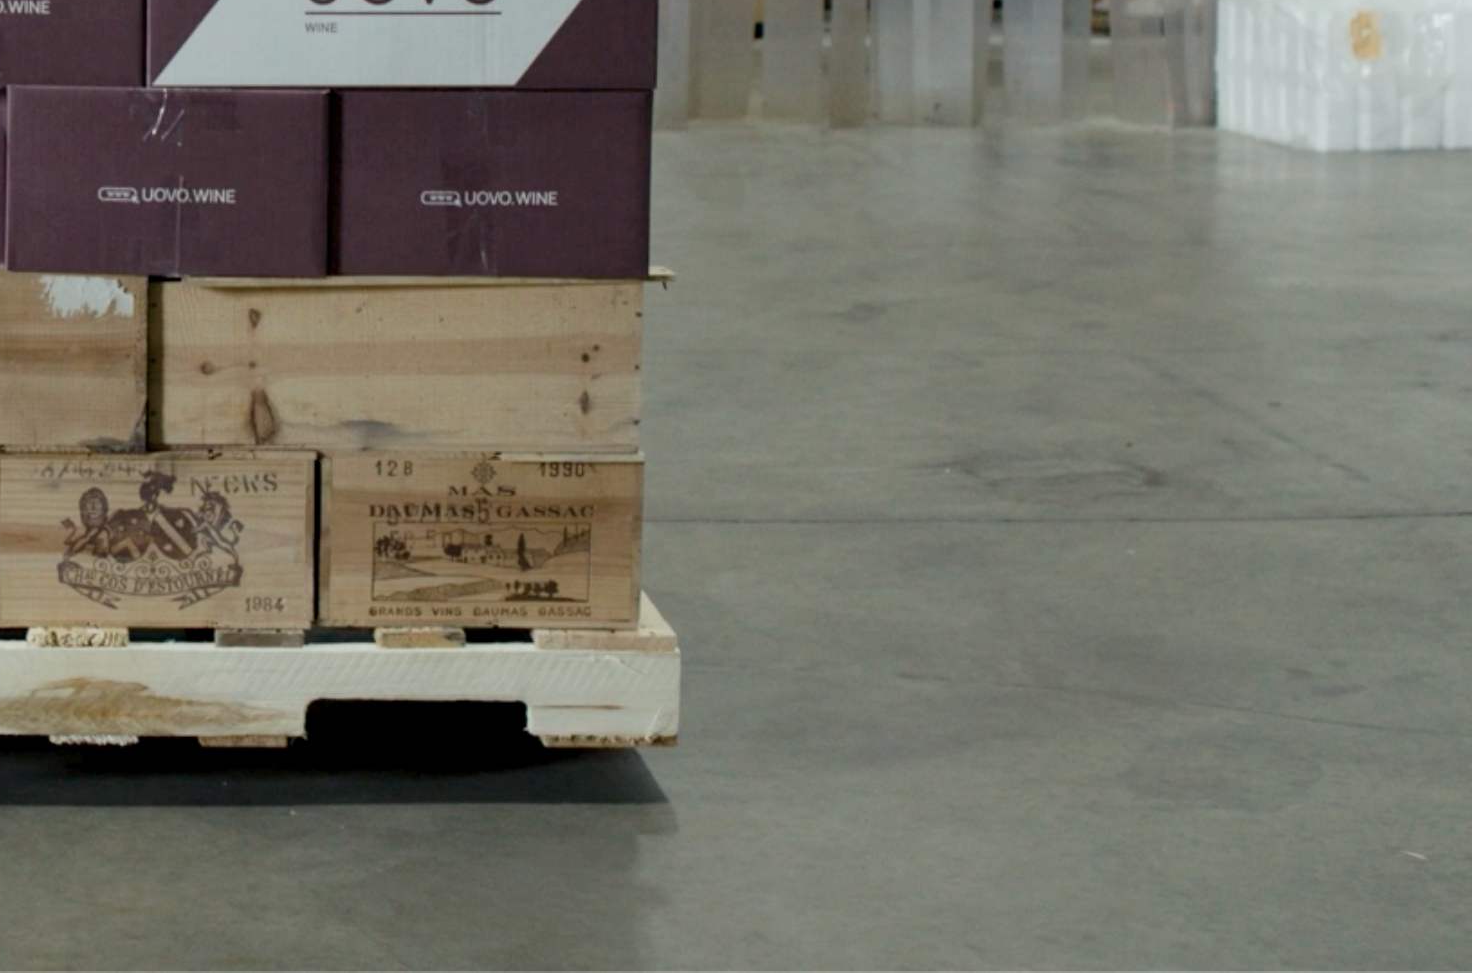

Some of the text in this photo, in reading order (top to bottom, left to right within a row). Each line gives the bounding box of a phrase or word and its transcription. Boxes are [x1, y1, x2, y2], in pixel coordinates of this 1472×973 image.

[304, 22, 339, 33] WINE
[140, 187, 237, 204] UOVO.WINE
[463, 190, 559, 207] UOVO.WINE
[375, 460, 414, 478] 128
[538, 461, 586, 478] 1990
[448, 485, 516, 497] MAS
[496, 504, 595, 519] GASSAC
[244, 596, 285, 613] 1984
[432, 606, 462, 617] VINS
